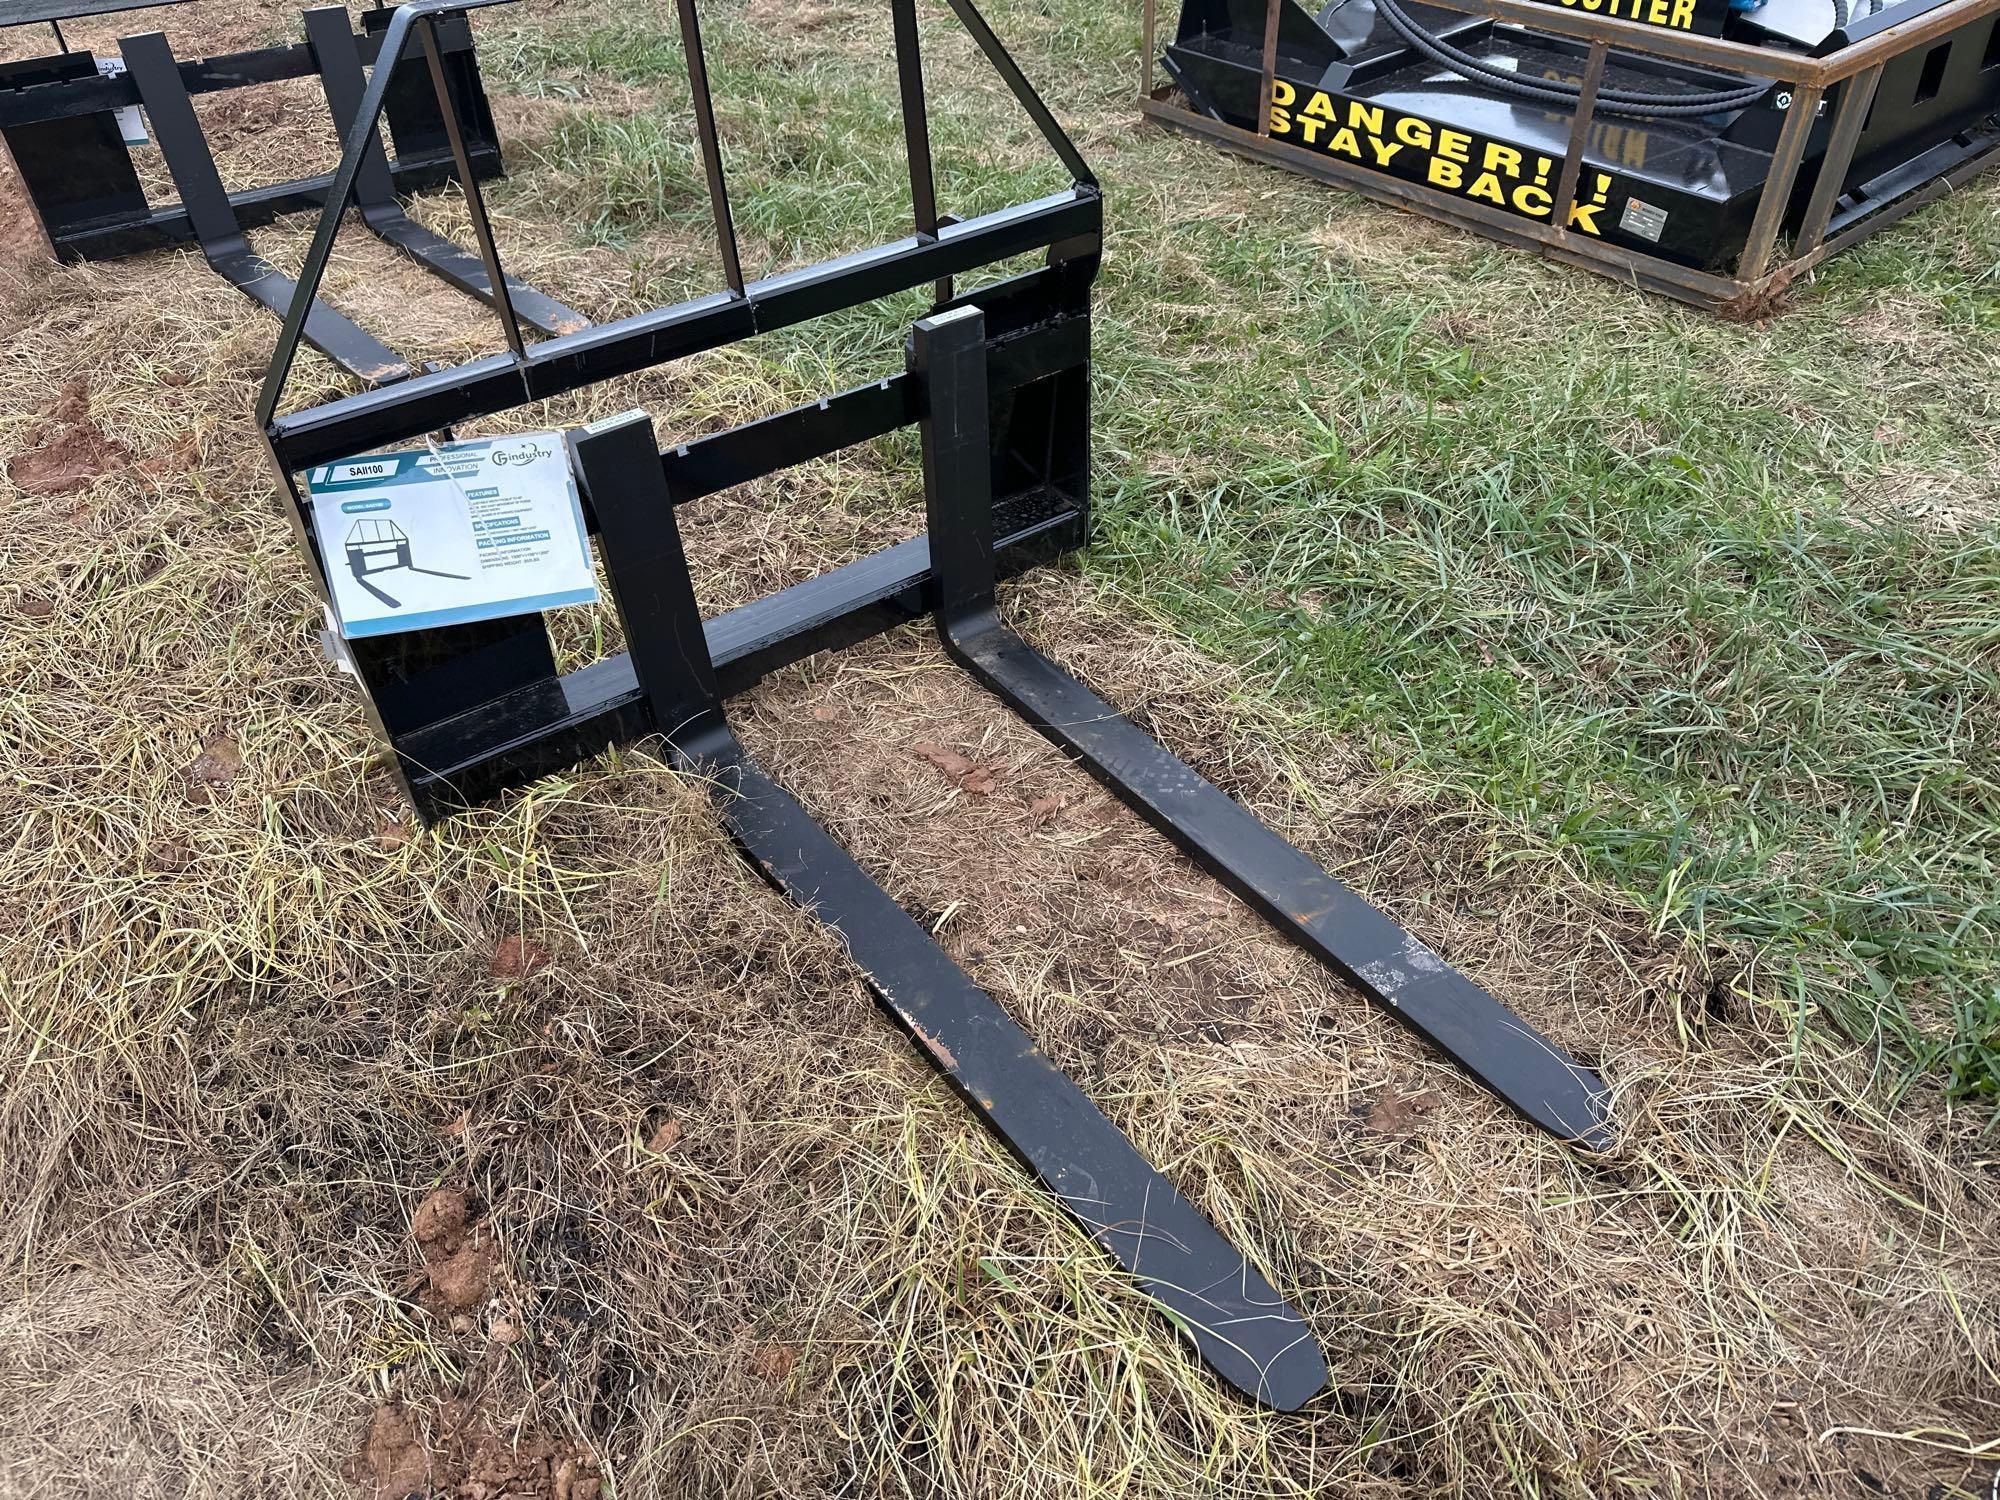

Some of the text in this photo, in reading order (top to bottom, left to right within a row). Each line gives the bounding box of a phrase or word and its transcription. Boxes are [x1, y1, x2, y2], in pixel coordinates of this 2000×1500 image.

[1562, 0, 1695, 29] TER
[1270, 107, 1606, 235] STAY BACK
[433, 462, 479, 474] INNOVATION
[467, 489, 498, 498] FEATURES
[478, 532, 549, 547] PACING INFORMATION
